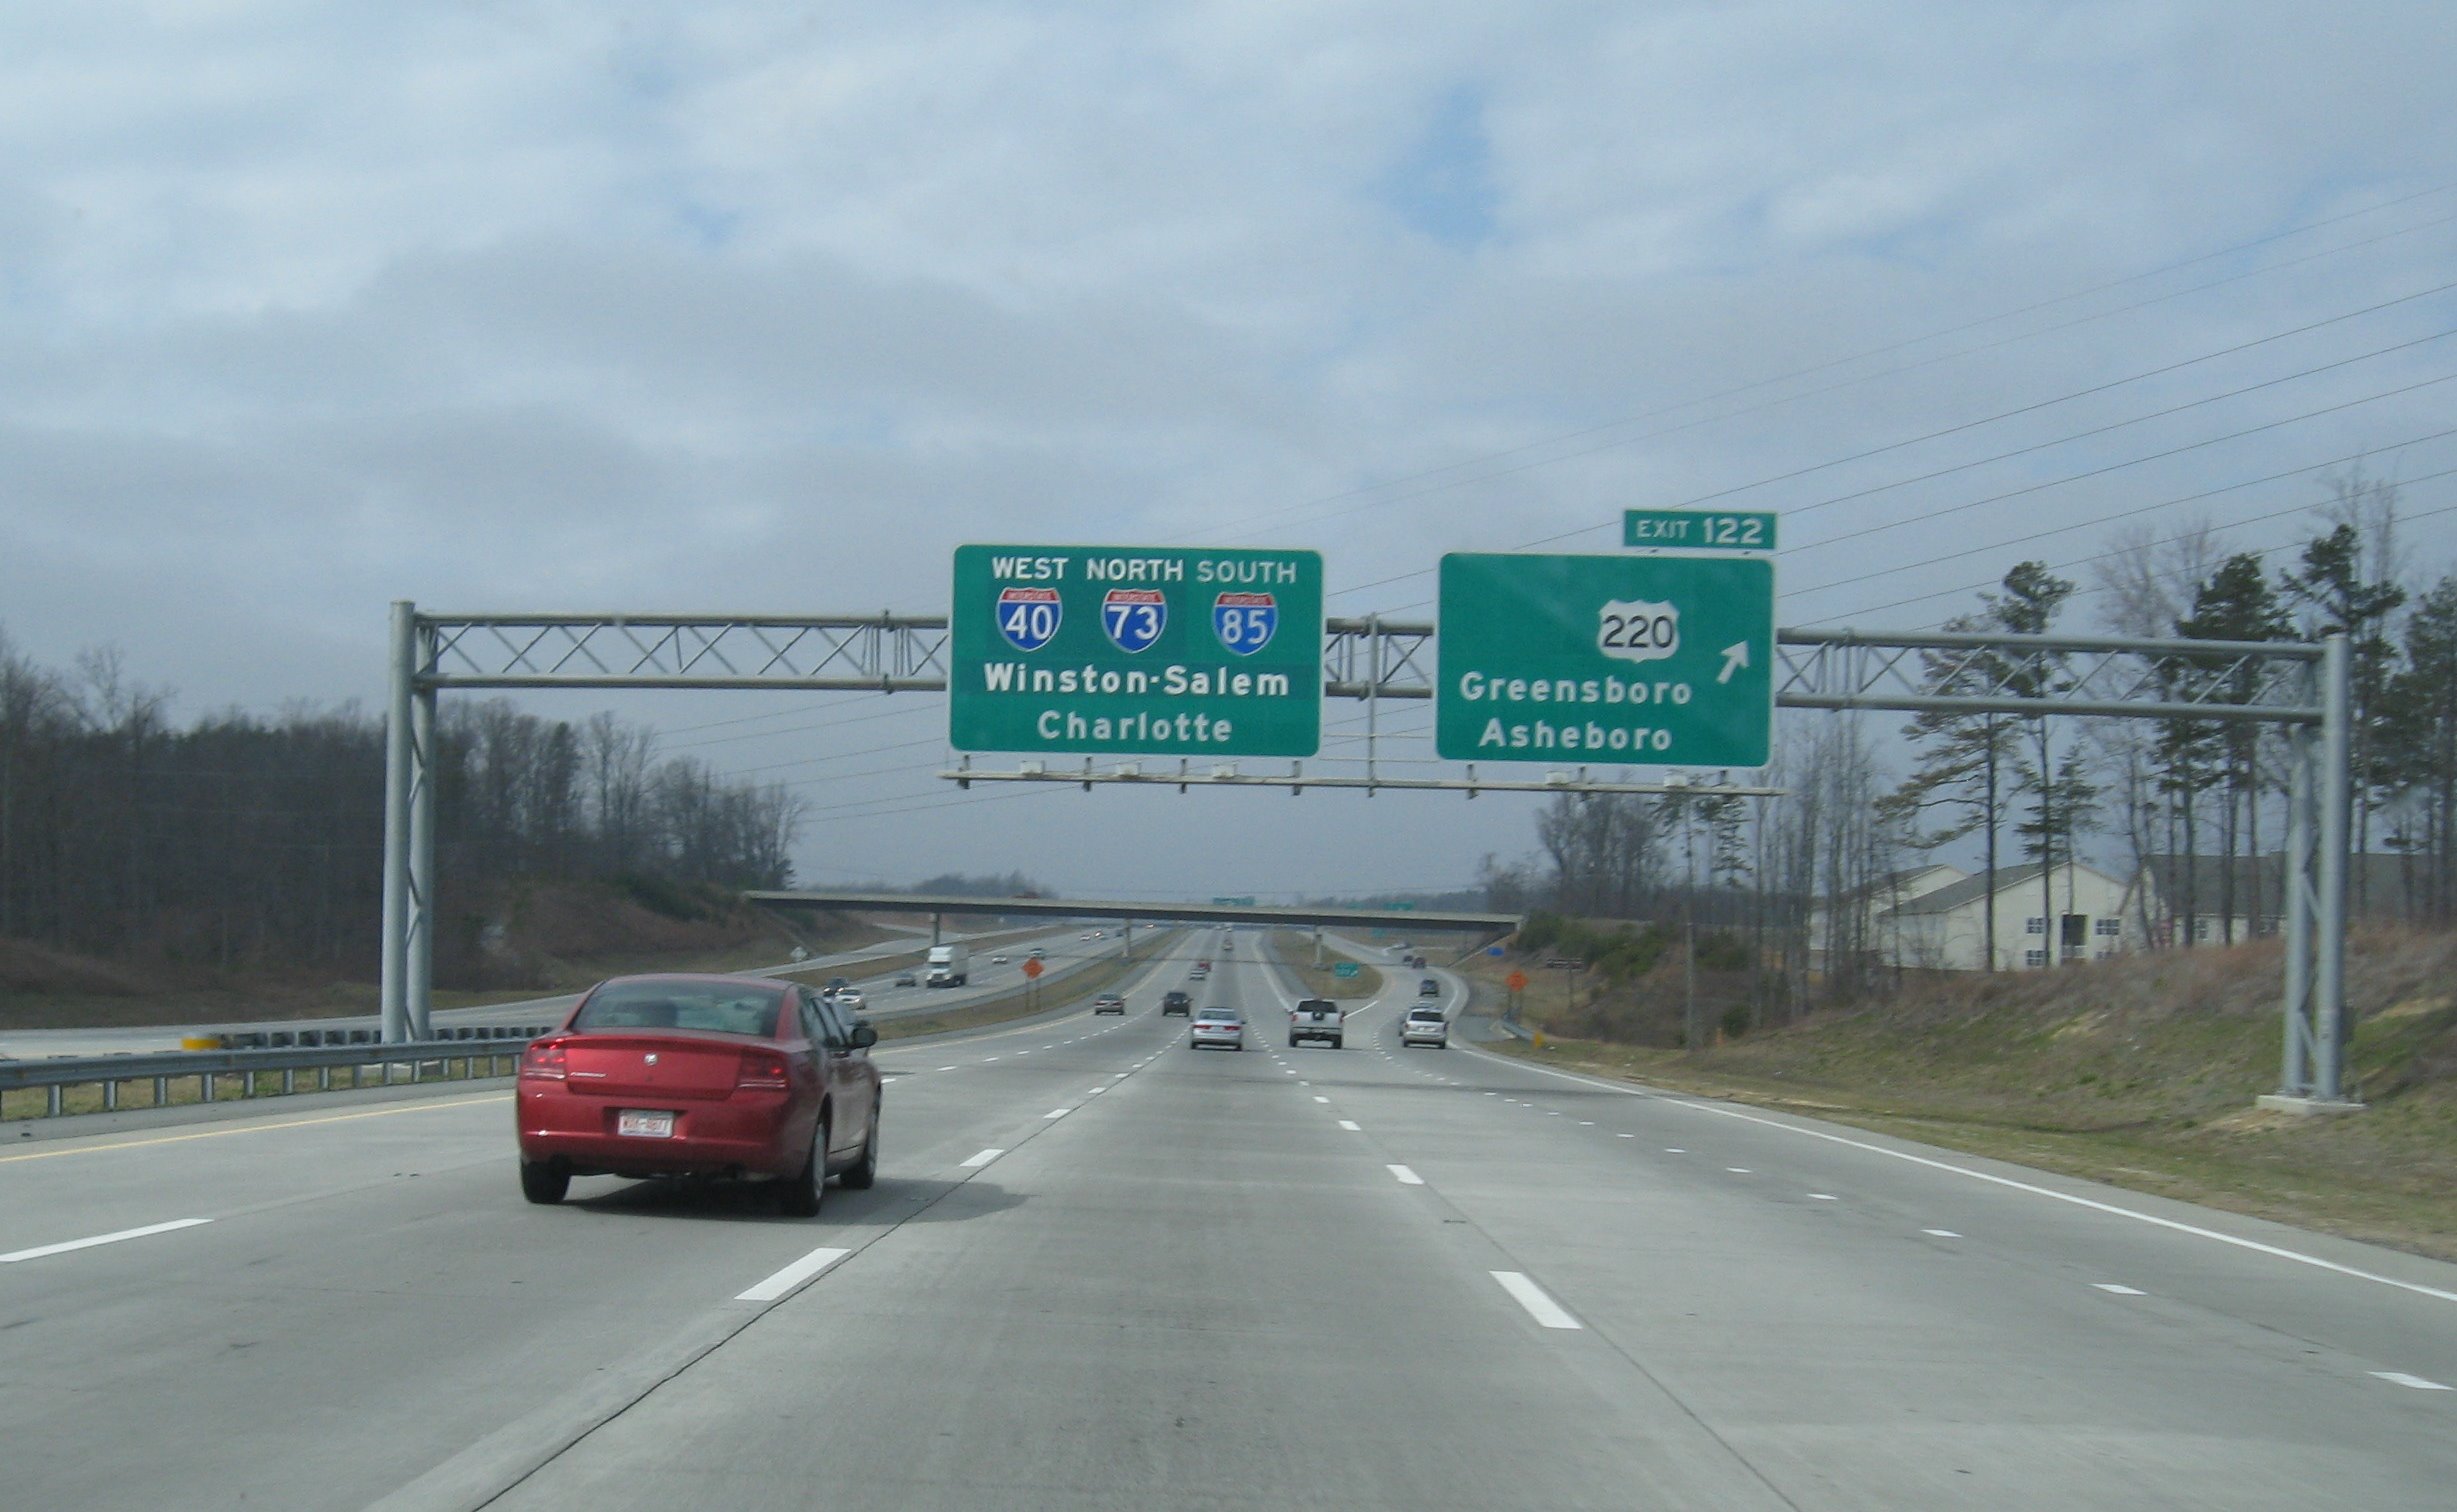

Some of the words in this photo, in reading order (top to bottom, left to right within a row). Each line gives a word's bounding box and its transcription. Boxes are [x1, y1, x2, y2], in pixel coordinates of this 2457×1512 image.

[1636, 520, 1690, 539] EXIT
[1703, 517, 1764, 545] 122
[992, 557, 1069, 580] WEST
[1087, 558, 1184, 582] NORTH
[1196, 559, 1297, 584] SOUTH
[1006, 606, 1052, 640] 40
[1107, 606, 1158, 639] 73
[1221, 609, 1268, 644] 85
[1603, 615, 1674, 649] 220
[984, 662, 1289, 696] Winston-Salem
[1460, 671, 1692, 705] Greensboro
[1038, 710, 1232, 741] Charlotte
[1478, 718, 1672, 751] Asheboro
